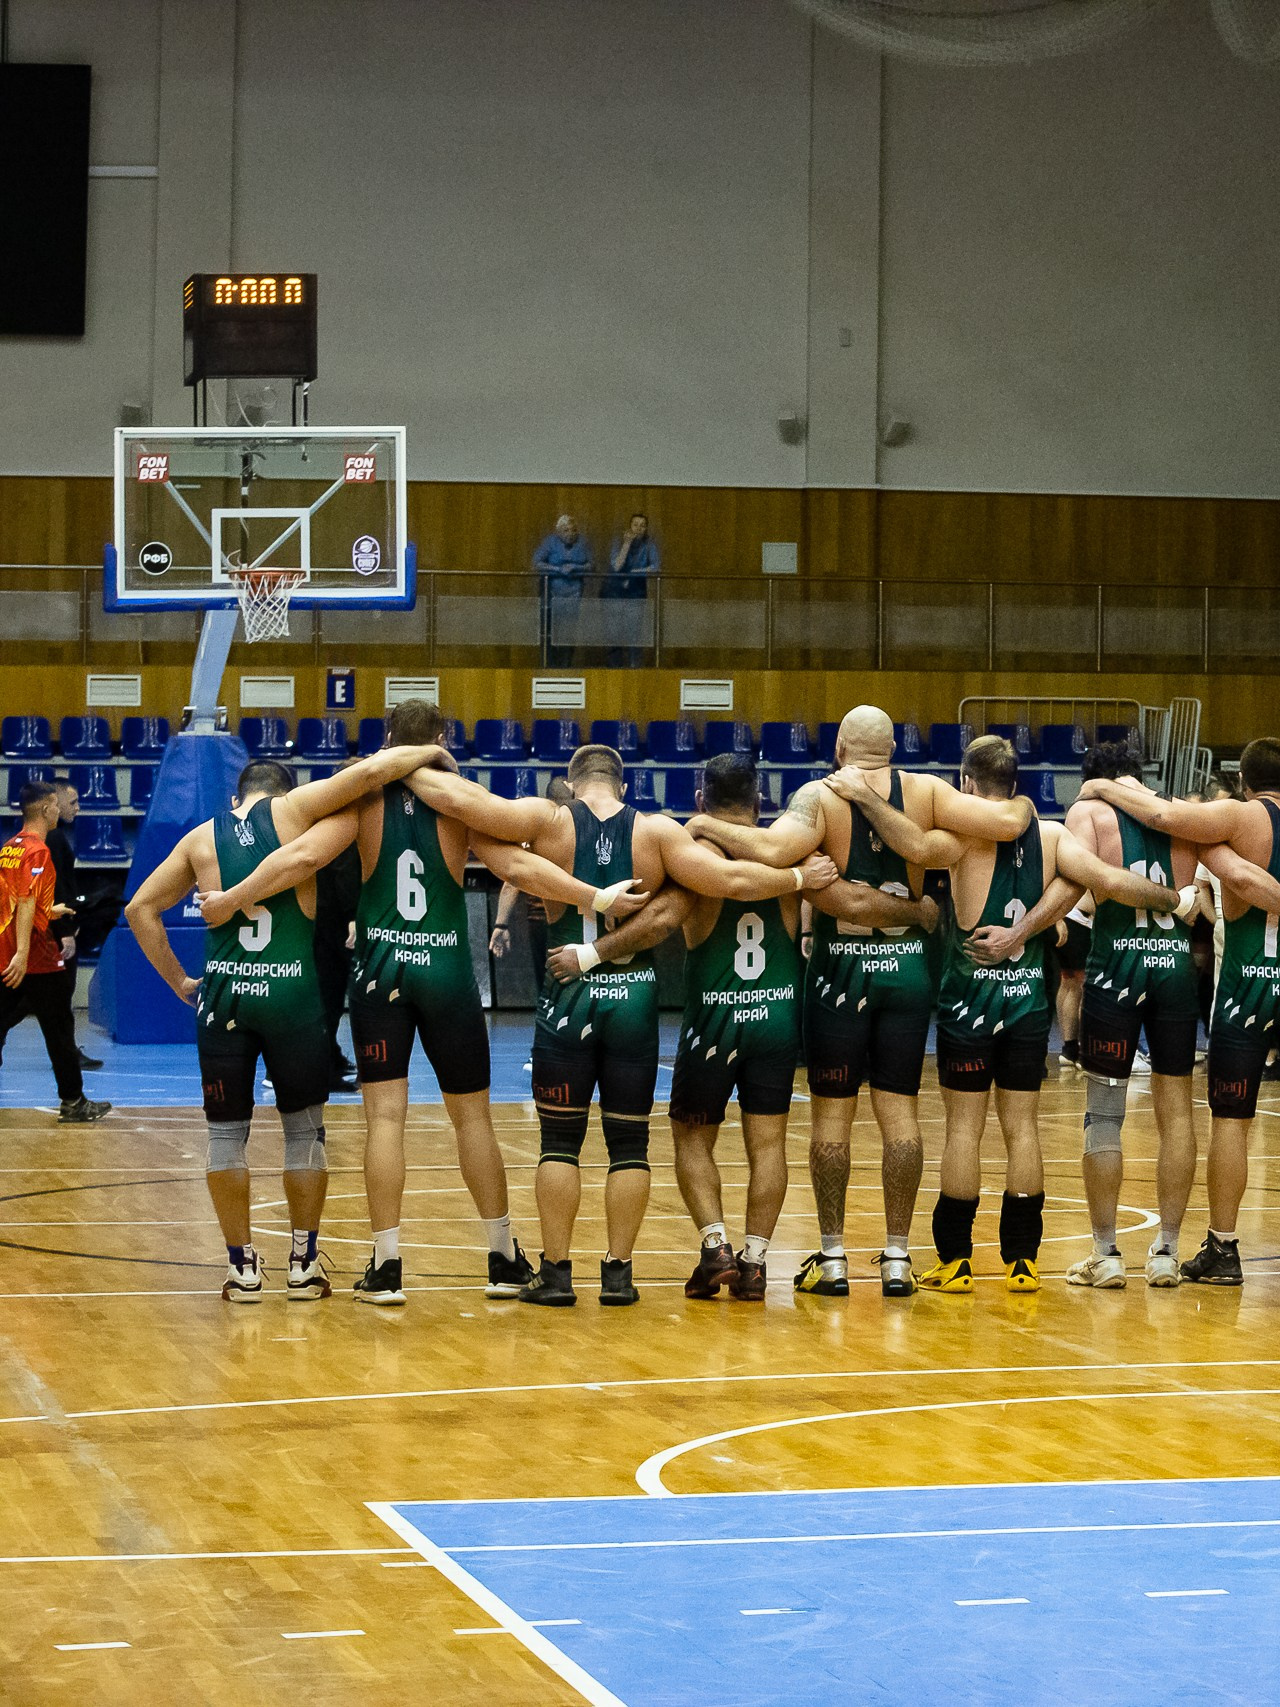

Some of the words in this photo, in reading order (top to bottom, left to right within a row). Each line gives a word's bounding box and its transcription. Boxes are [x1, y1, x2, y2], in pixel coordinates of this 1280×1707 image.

[139, 456, 167, 468] FON
[345, 457, 374, 468] FON
[139, 468, 167, 480] BET
[345, 468, 374, 480] BET
[143, 553, 168, 564] РФБ
[396, 848, 428, 921] 6
[367, 926, 458, 947] КРАСНОЯРСКИЙ
[734, 911, 766, 980] 8
[828, 940, 923, 955] КРАСНОЯРСКИЙ
[394, 948, 431, 966] КРАЙ
[862, 957, 899, 973] КРАЙ
[1143, 953, 1176, 968] КРАЙ
[206, 960, 302, 978] КРАСНОЯРСКИЙ
[579, 967, 656, 984] СНОЯРСКИЙ
[231, 980, 270, 997] КРАЙ
[589, 986, 629, 1000] КРАЙ
[702, 983, 794, 1005] КРАСНОЯРСКИЙ
[1003, 982, 1031, 997] КРАЙ
[734, 1004, 769, 1023] КРАЙ
